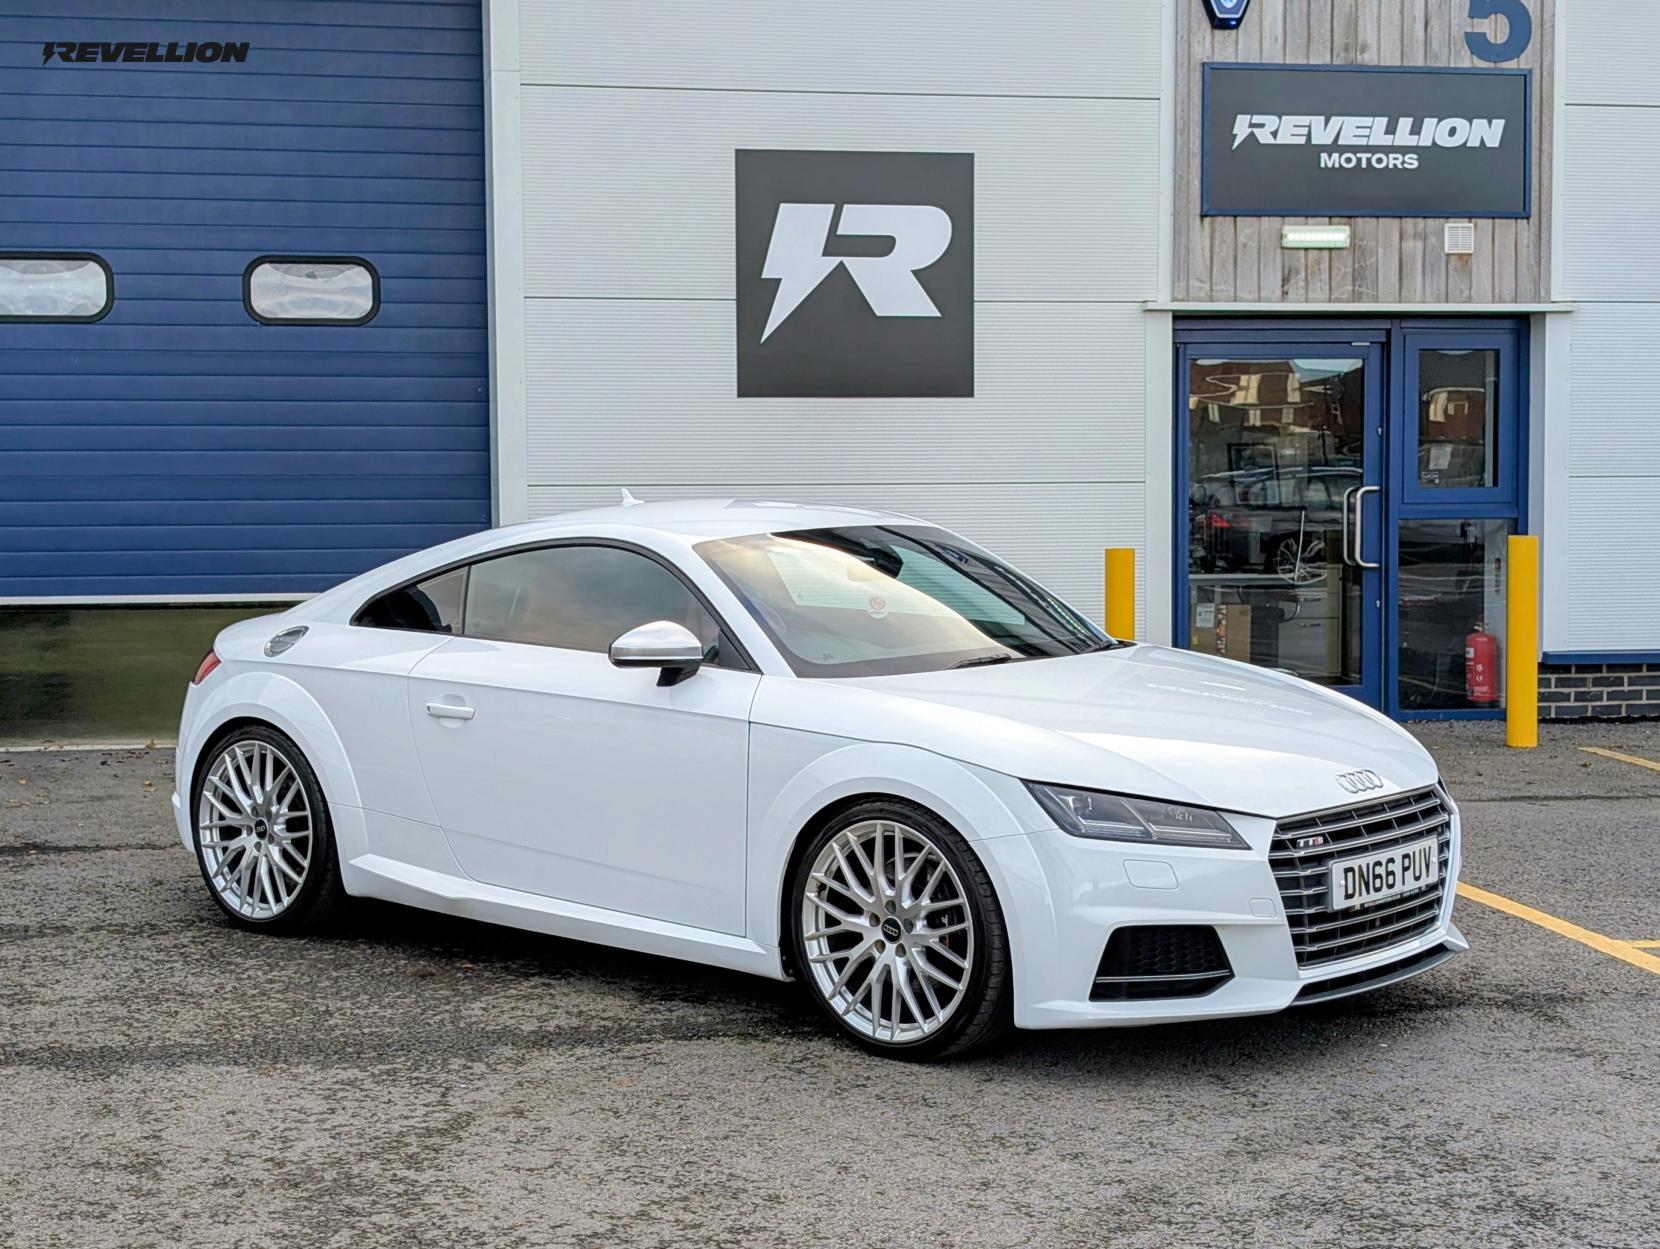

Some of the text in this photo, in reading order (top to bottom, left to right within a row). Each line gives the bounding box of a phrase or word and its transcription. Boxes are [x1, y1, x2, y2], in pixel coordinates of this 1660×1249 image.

[1465, 0, 1532, 62] 5
[1232, 115, 1505, 150] REVELLION
[1320, 153, 1419, 170] MOTORS
[1343, 857, 1396, 900] DN66
[1401, 846, 1432, 886] PUV
